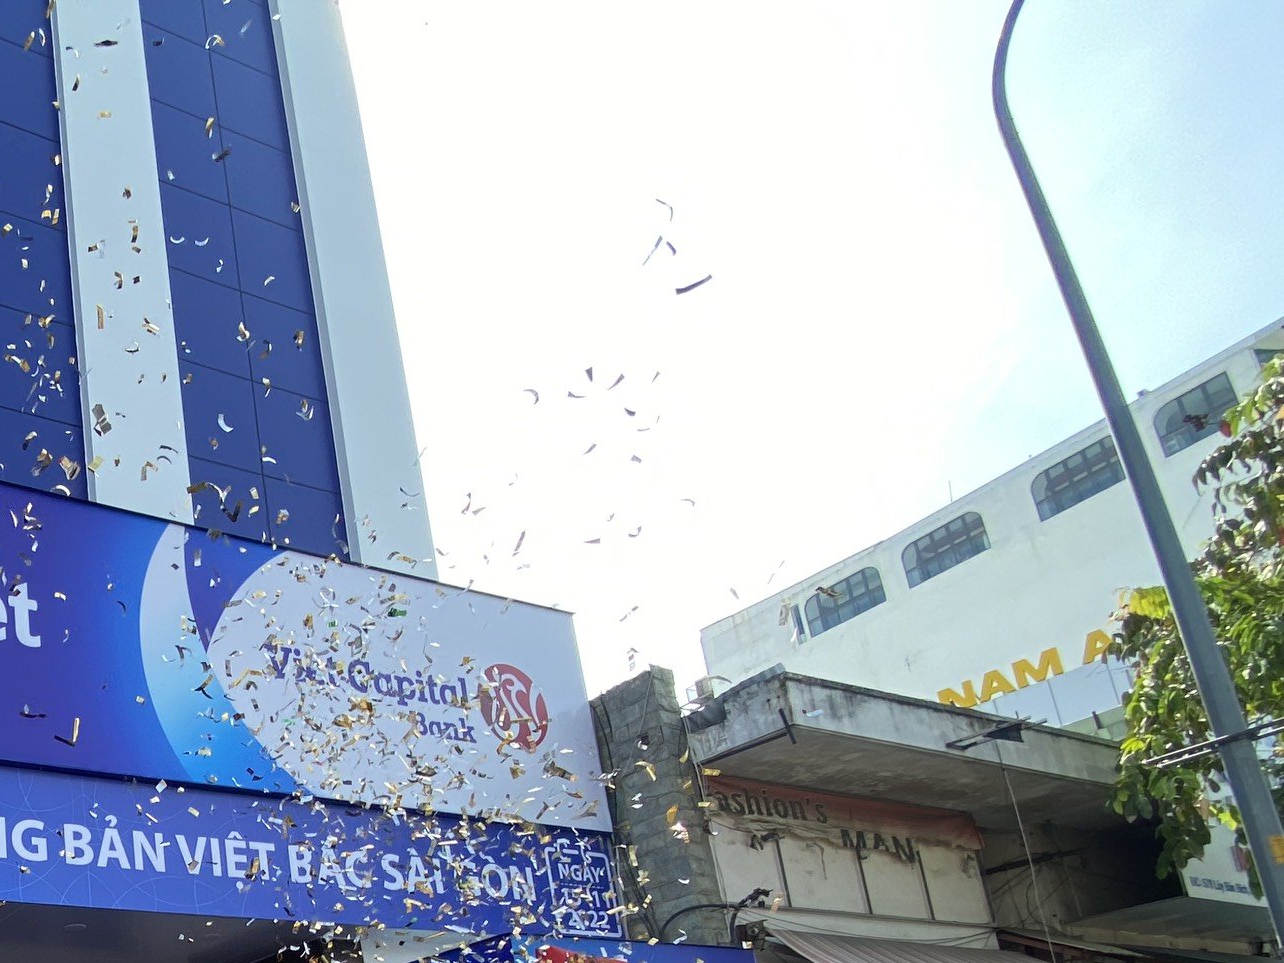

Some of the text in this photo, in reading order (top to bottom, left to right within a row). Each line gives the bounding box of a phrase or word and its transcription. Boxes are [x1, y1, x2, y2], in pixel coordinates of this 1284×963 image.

[347, 657, 469, 707] Capital
[936, 646, 1064, 708] NAM
[414, 711, 477, 744] Bank
[62, 814, 167, 873] BẢN
[175, 830, 275, 890] VIỆT
